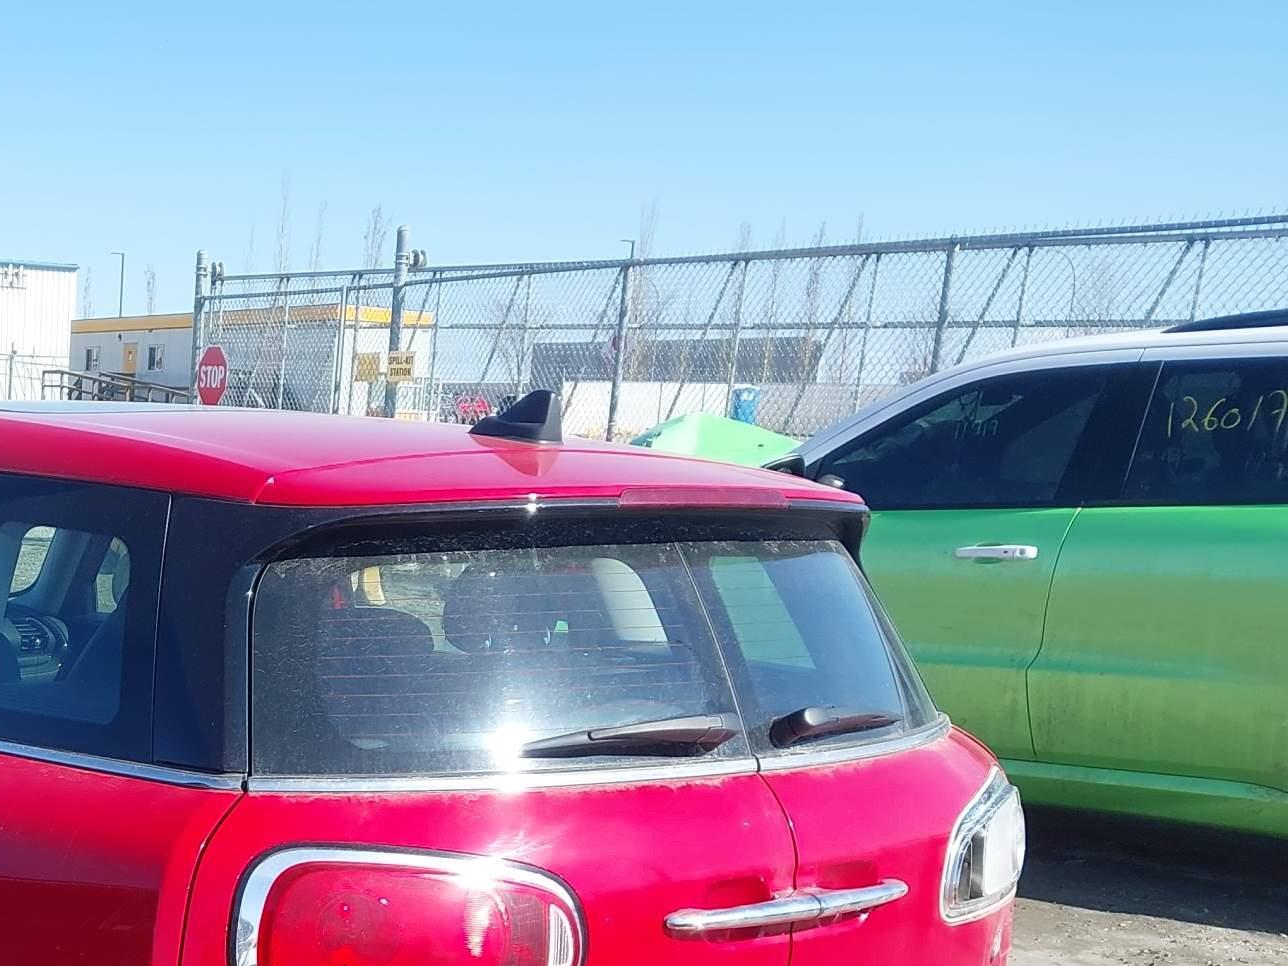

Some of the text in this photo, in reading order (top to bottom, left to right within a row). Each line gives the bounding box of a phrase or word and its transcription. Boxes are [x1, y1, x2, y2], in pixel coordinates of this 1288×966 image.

[388, 356, 414, 365] SPILL-KIT
[200, 365, 225, 388] STOP
[390, 367, 411, 377] STATION
